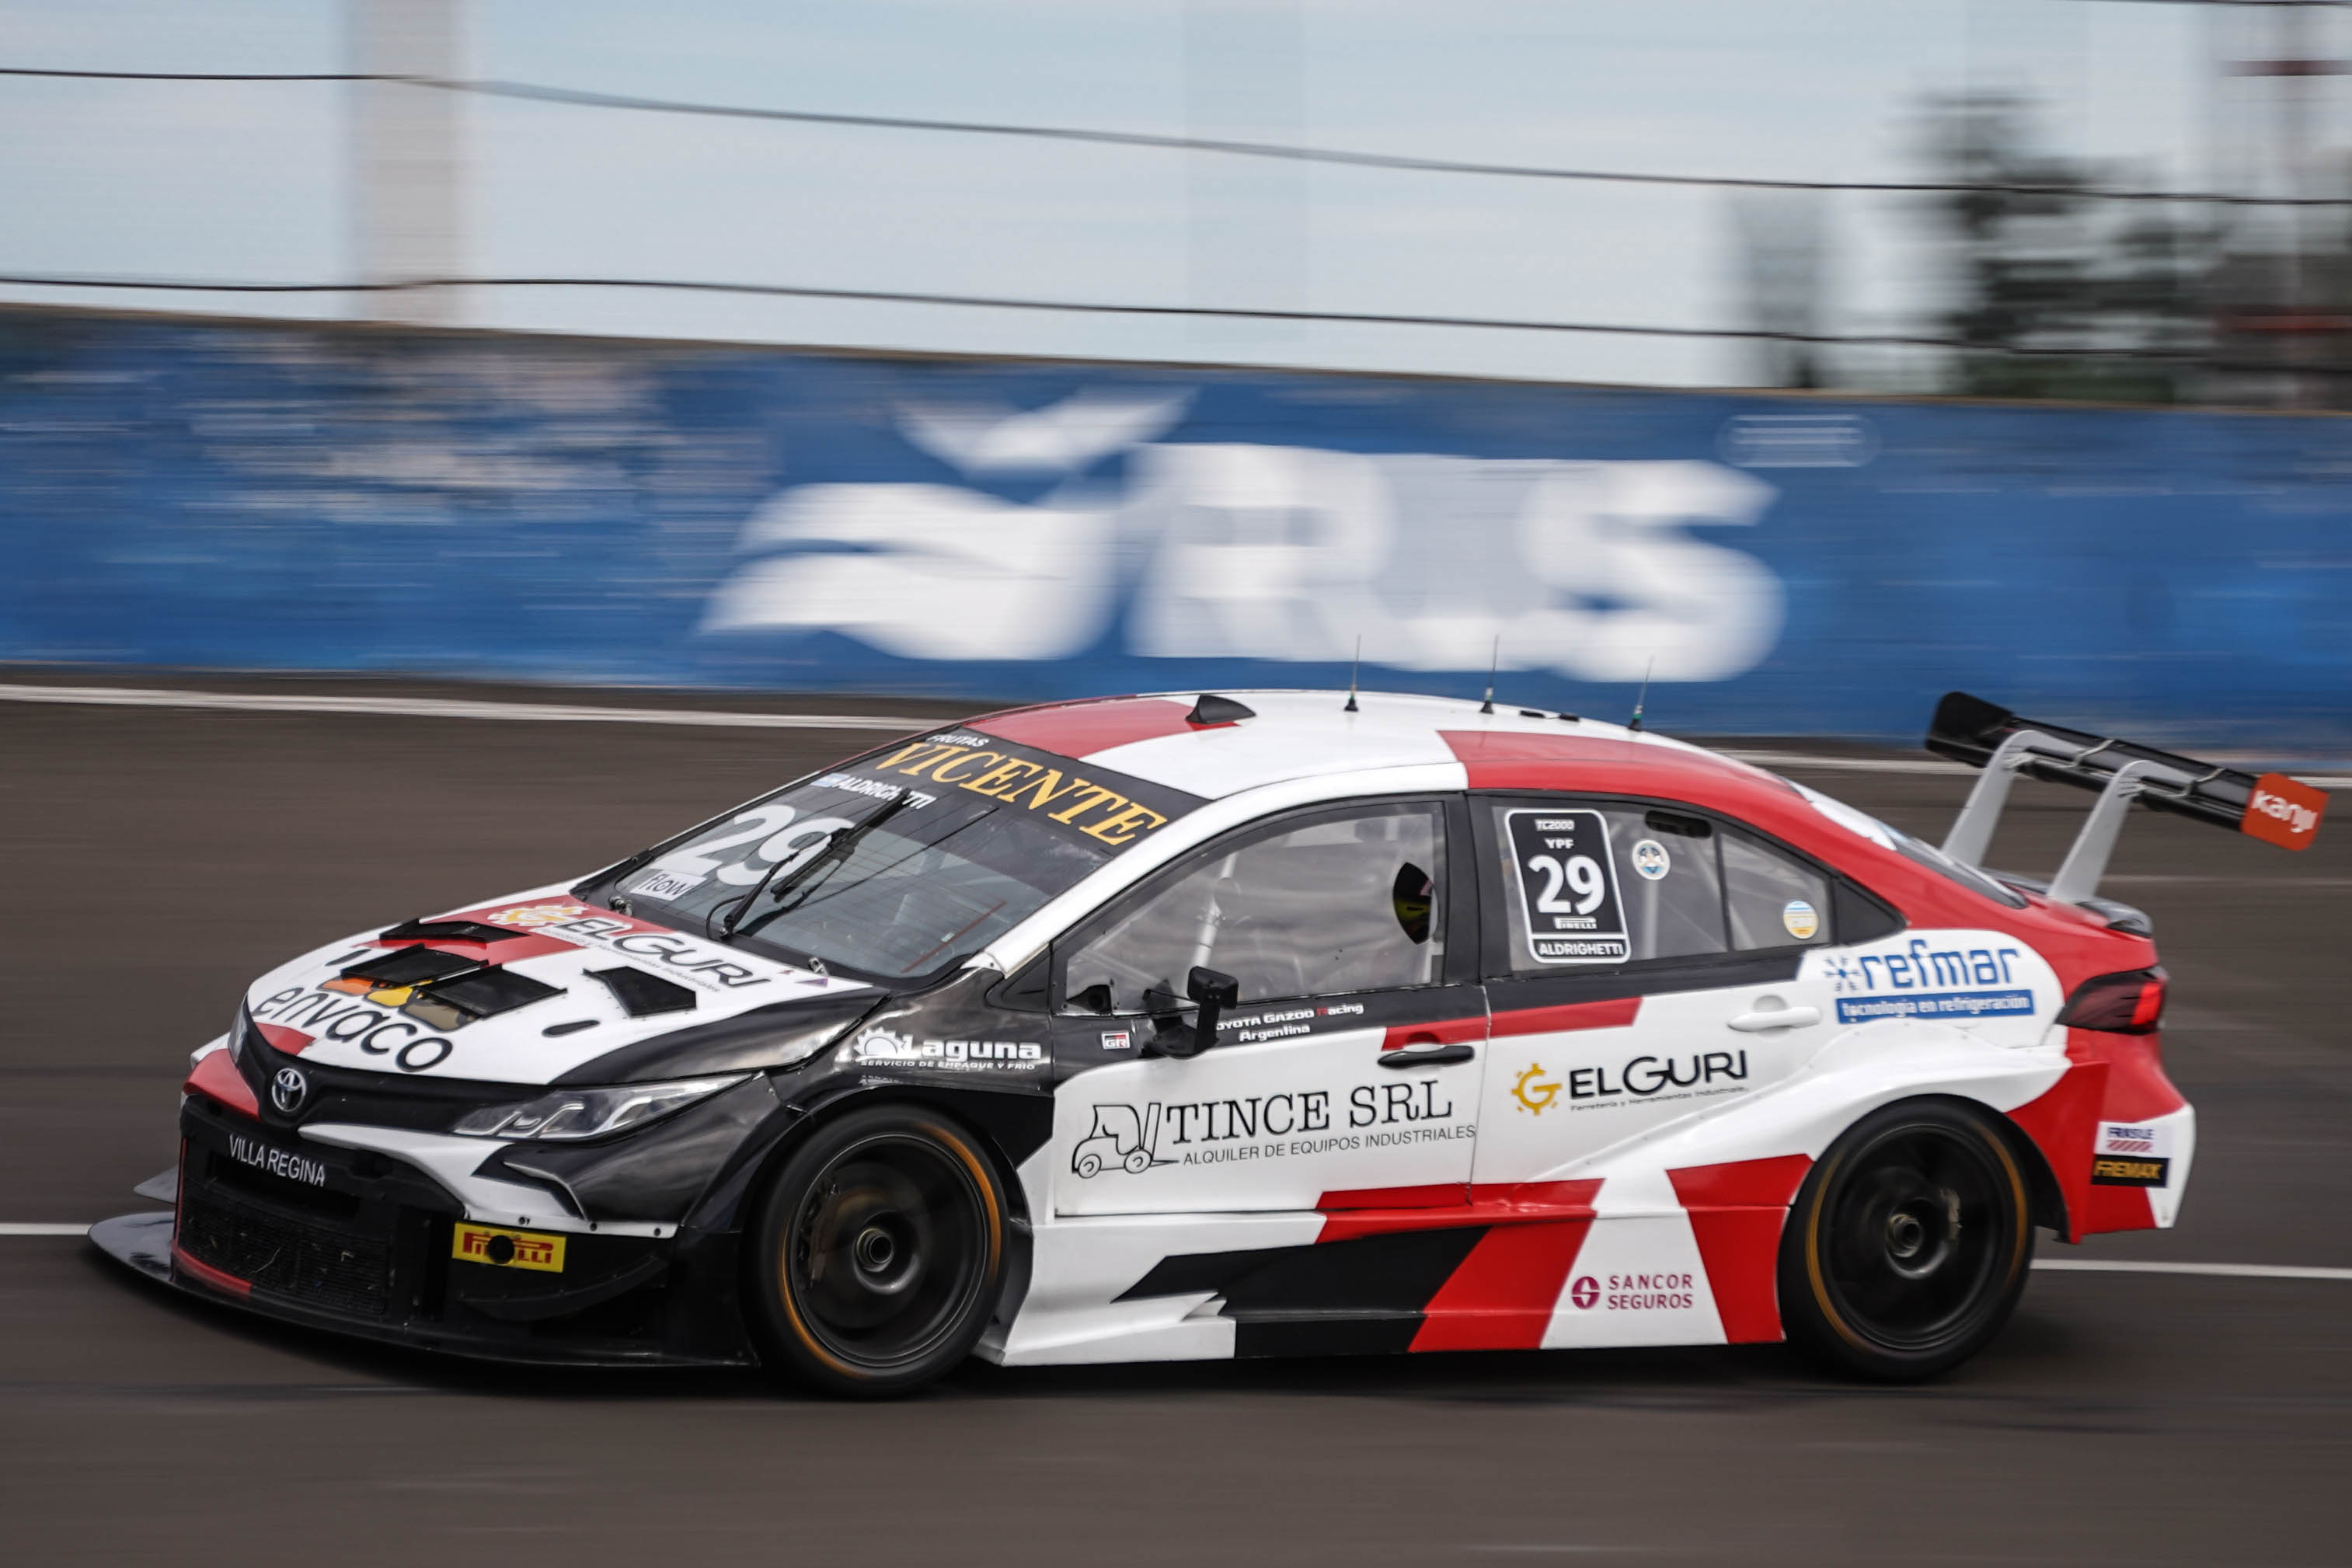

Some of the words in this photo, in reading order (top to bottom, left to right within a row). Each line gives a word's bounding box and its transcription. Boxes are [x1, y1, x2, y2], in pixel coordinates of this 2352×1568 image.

[925, 733, 990, 747] FRUTAS
[831, 777, 938, 810] ALDRIGHTTI
[876, 741, 1169, 846] VICENTE
[647, 804, 855, 886] 29
[1545, 838, 1574, 848] YPF
[638, 871, 693, 896] flow
[1528, 855, 1605, 915] 29
[1554, 917, 1598, 929] PIRELLI
[1539, 943, 1624, 956] ALDRIGHETTI
[1859, 939, 2020, 990] refmar
[1216, 1017, 1261, 1030] OYOTA
[1316, 1004, 1364, 1016] Racing
[1918, 1001, 1938, 1012] en
[251, 987, 454, 1072] envaco
[1239, 1024, 1311, 1041] Argentina
[897, 1034, 1041, 1062] Laguna
[1570, 1050, 1748, 1099] ELGURI
[1166, 1091, 1331, 1145] TINCE
[1349, 1079, 1453, 1129] SRL
[1183, 1145, 1260, 1166] ALQUILER
[1264, 1144, 1286, 1158] DE
[1291, 1136, 1361, 1156] EQUIPOS
[1365, 1124, 1476, 1148] INDUSTRIALES
[229, 1134, 264, 1169] VILLA
[267, 1148, 326, 1187] REGINA
[462, 1232, 554, 1264] PILLI
[1608, 1274, 1693, 1290] SANCOR
[1608, 1294, 1693, 1310] SEGUROS
